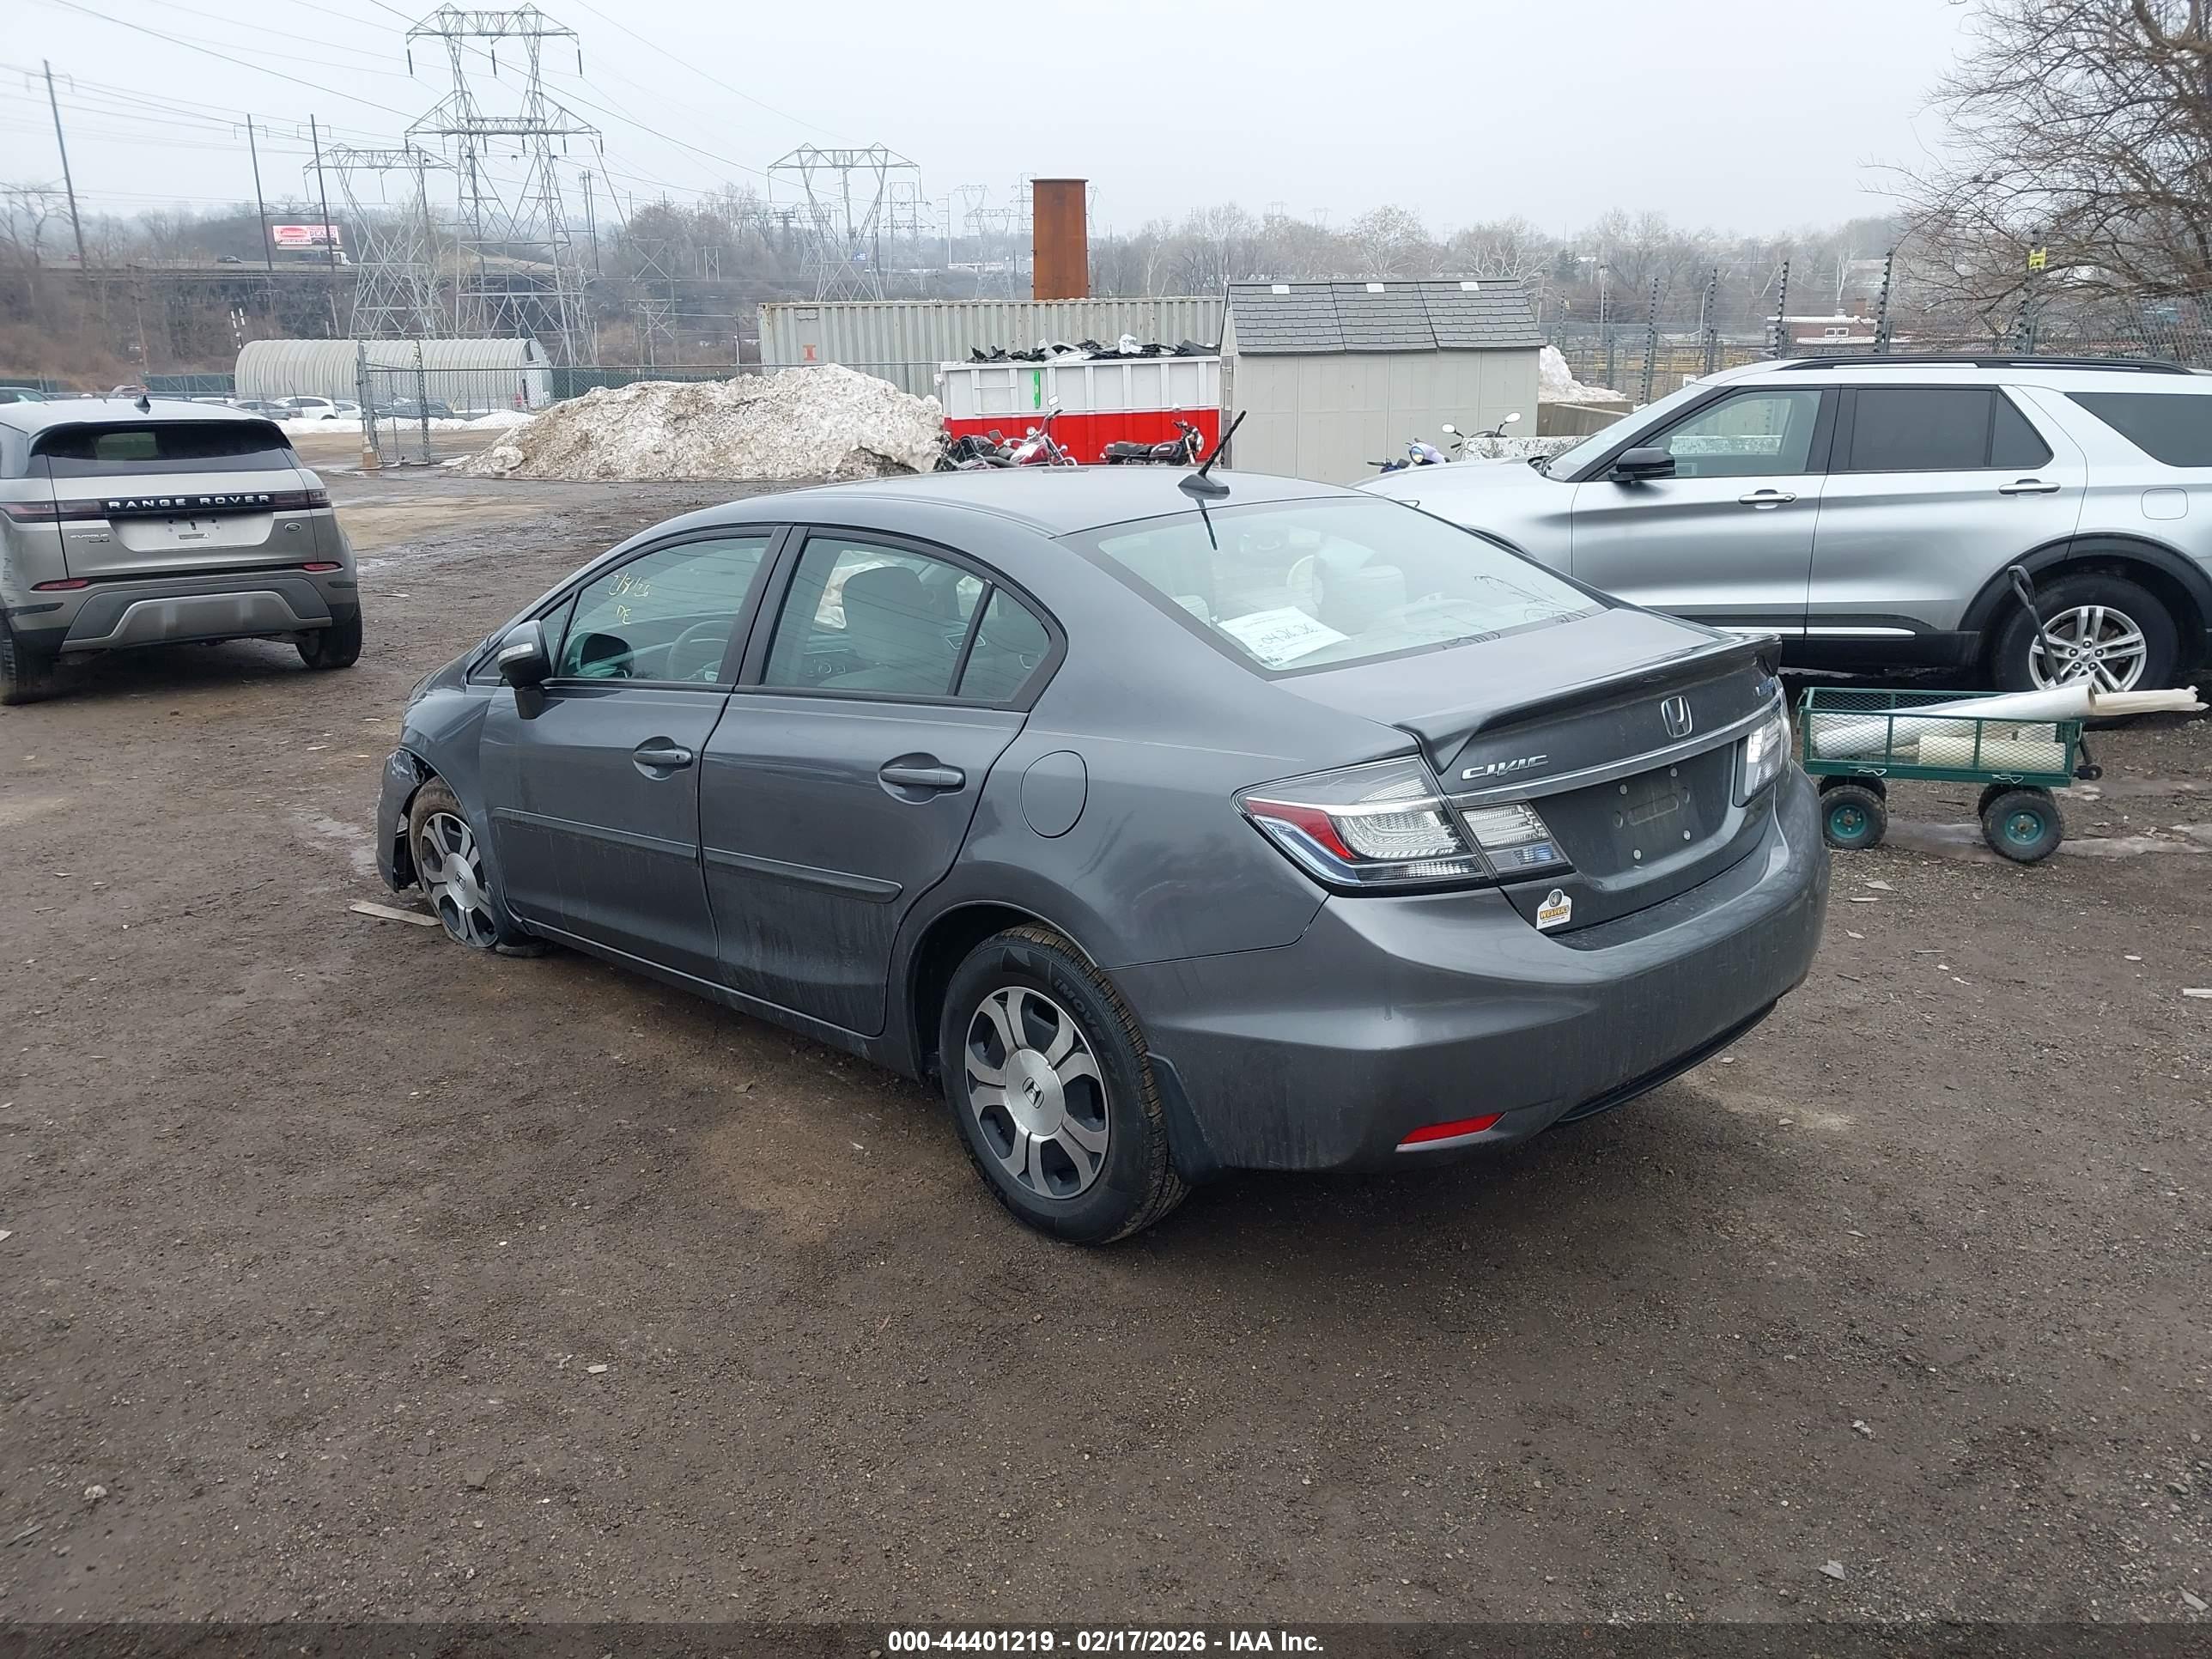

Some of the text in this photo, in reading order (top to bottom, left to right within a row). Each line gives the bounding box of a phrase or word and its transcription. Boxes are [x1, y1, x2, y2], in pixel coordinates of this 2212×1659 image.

[108, 495, 270, 509] RANGE ROVER
[1462, 754, 1549, 780] CIVIC
